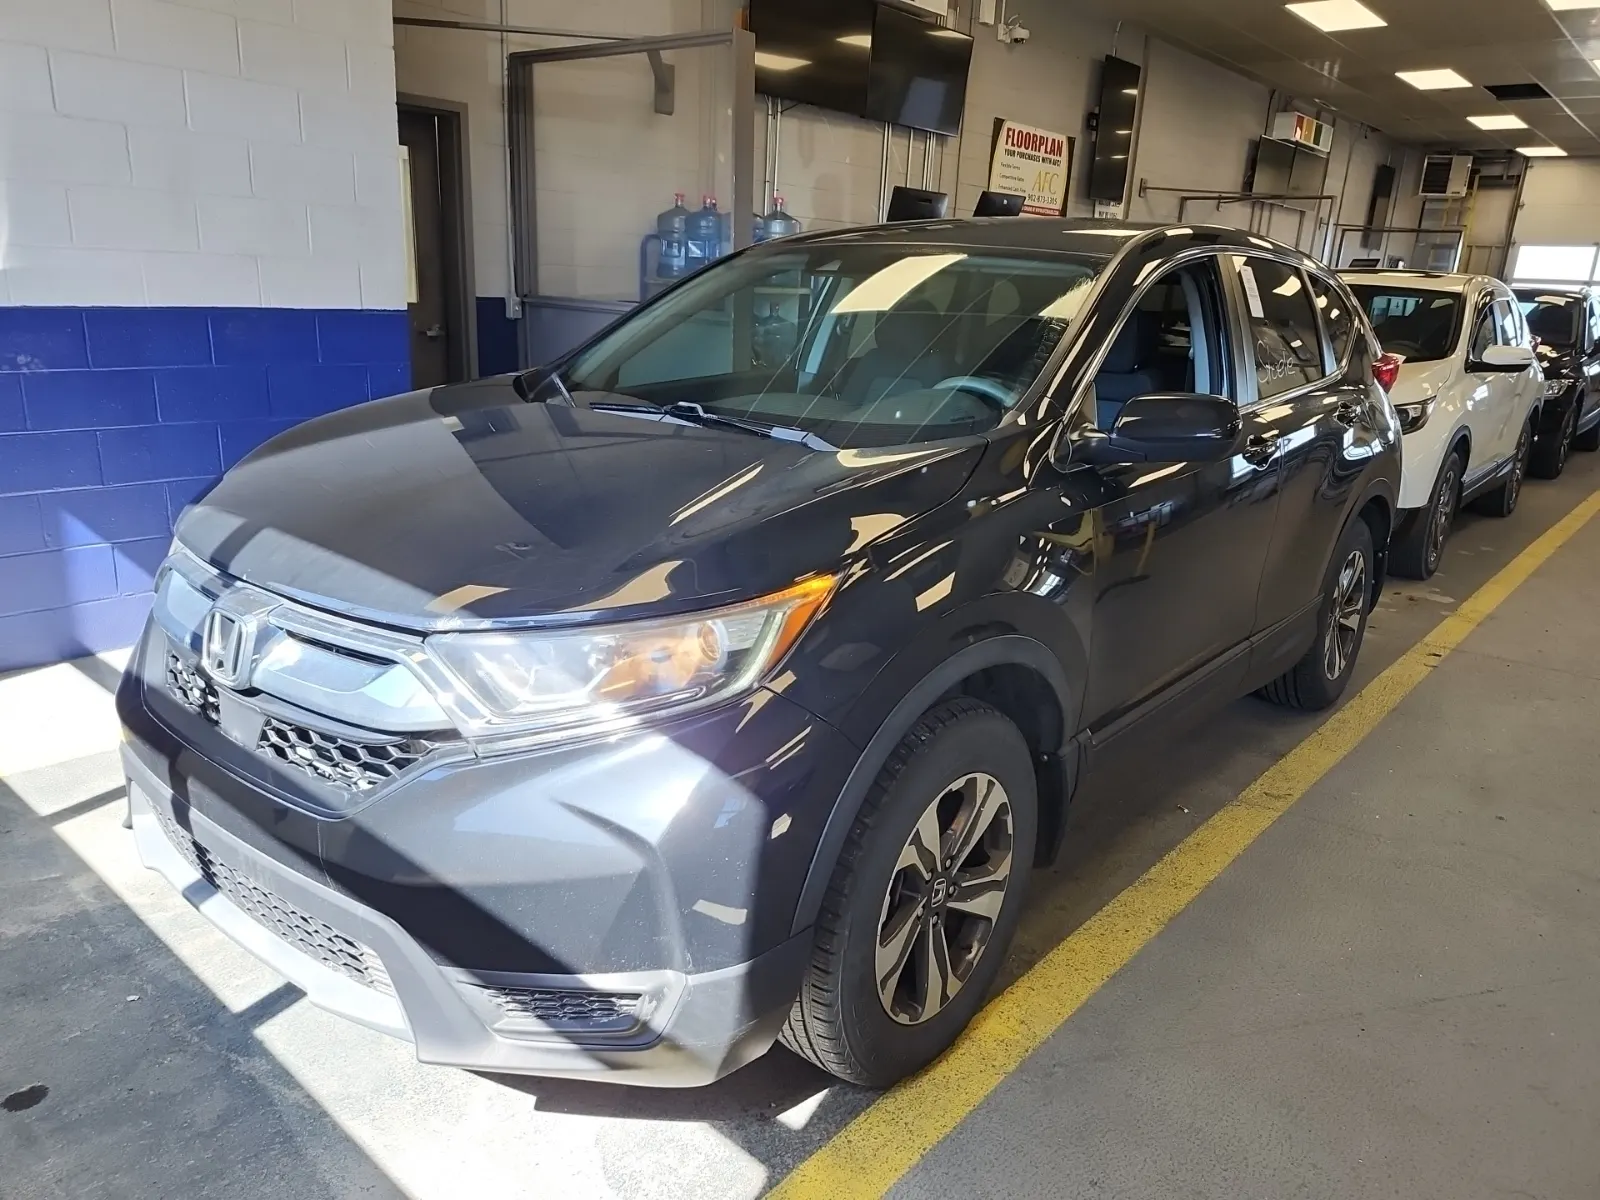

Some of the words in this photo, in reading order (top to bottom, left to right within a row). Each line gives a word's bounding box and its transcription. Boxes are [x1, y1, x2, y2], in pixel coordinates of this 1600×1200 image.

[1005, 127, 1064, 158] FLOORPLAN
[1004, 148, 1016, 157] YOUR
[1016, 151, 1041, 163] PURCHASES
[1041, 156, 1052, 165] WITH
[1032, 170, 1059, 195] AFC
